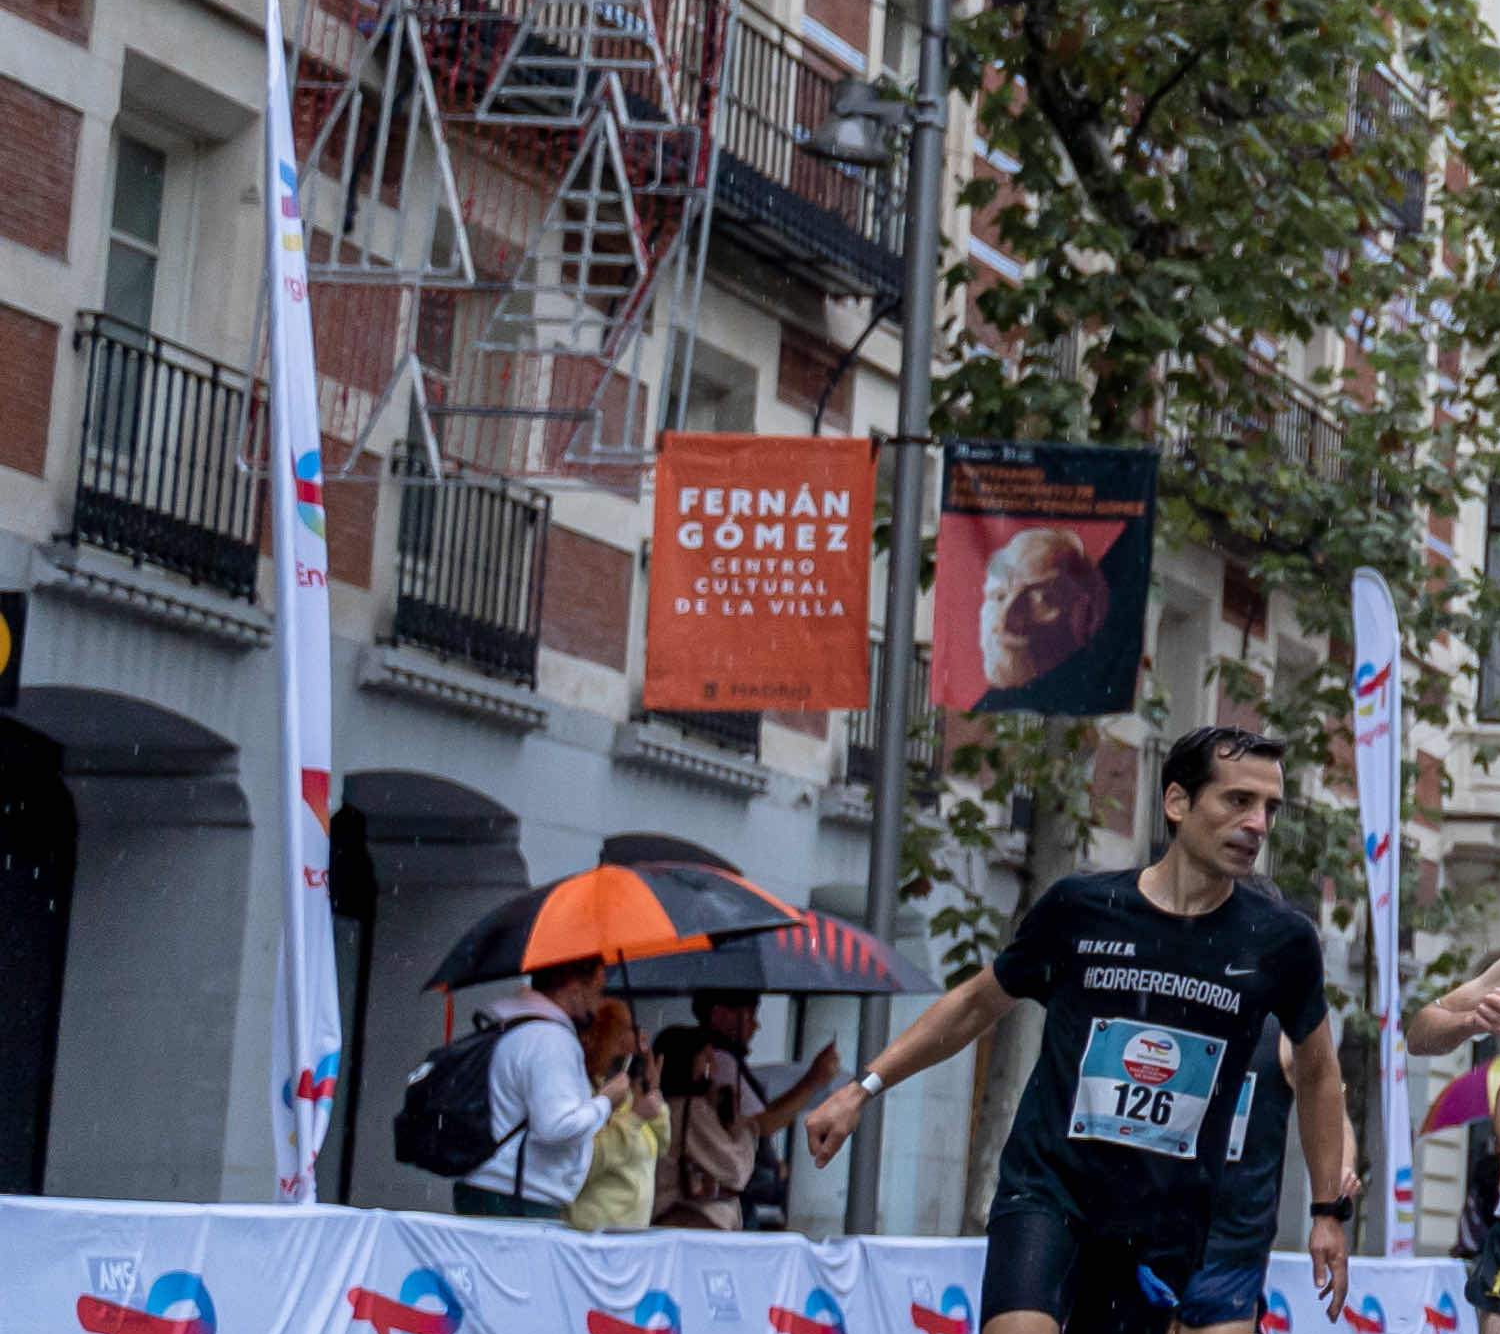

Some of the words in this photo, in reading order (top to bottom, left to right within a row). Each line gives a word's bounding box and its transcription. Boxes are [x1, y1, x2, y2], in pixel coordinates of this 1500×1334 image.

[678, 483, 850, 518] FERNÁN
[677, 515, 848, 552] GÓMEZ
[710, 557, 815, 575] CENTRO
[693, 578, 828, 596] CULTURAL
[674, 598, 707, 615] DE
[722, 600, 754, 616] LA
[768, 600, 845, 616] VILLA
[1083, 966, 1240, 1015] #CORRERENGORDA
[1113, 1082, 1175, 1126] 126
